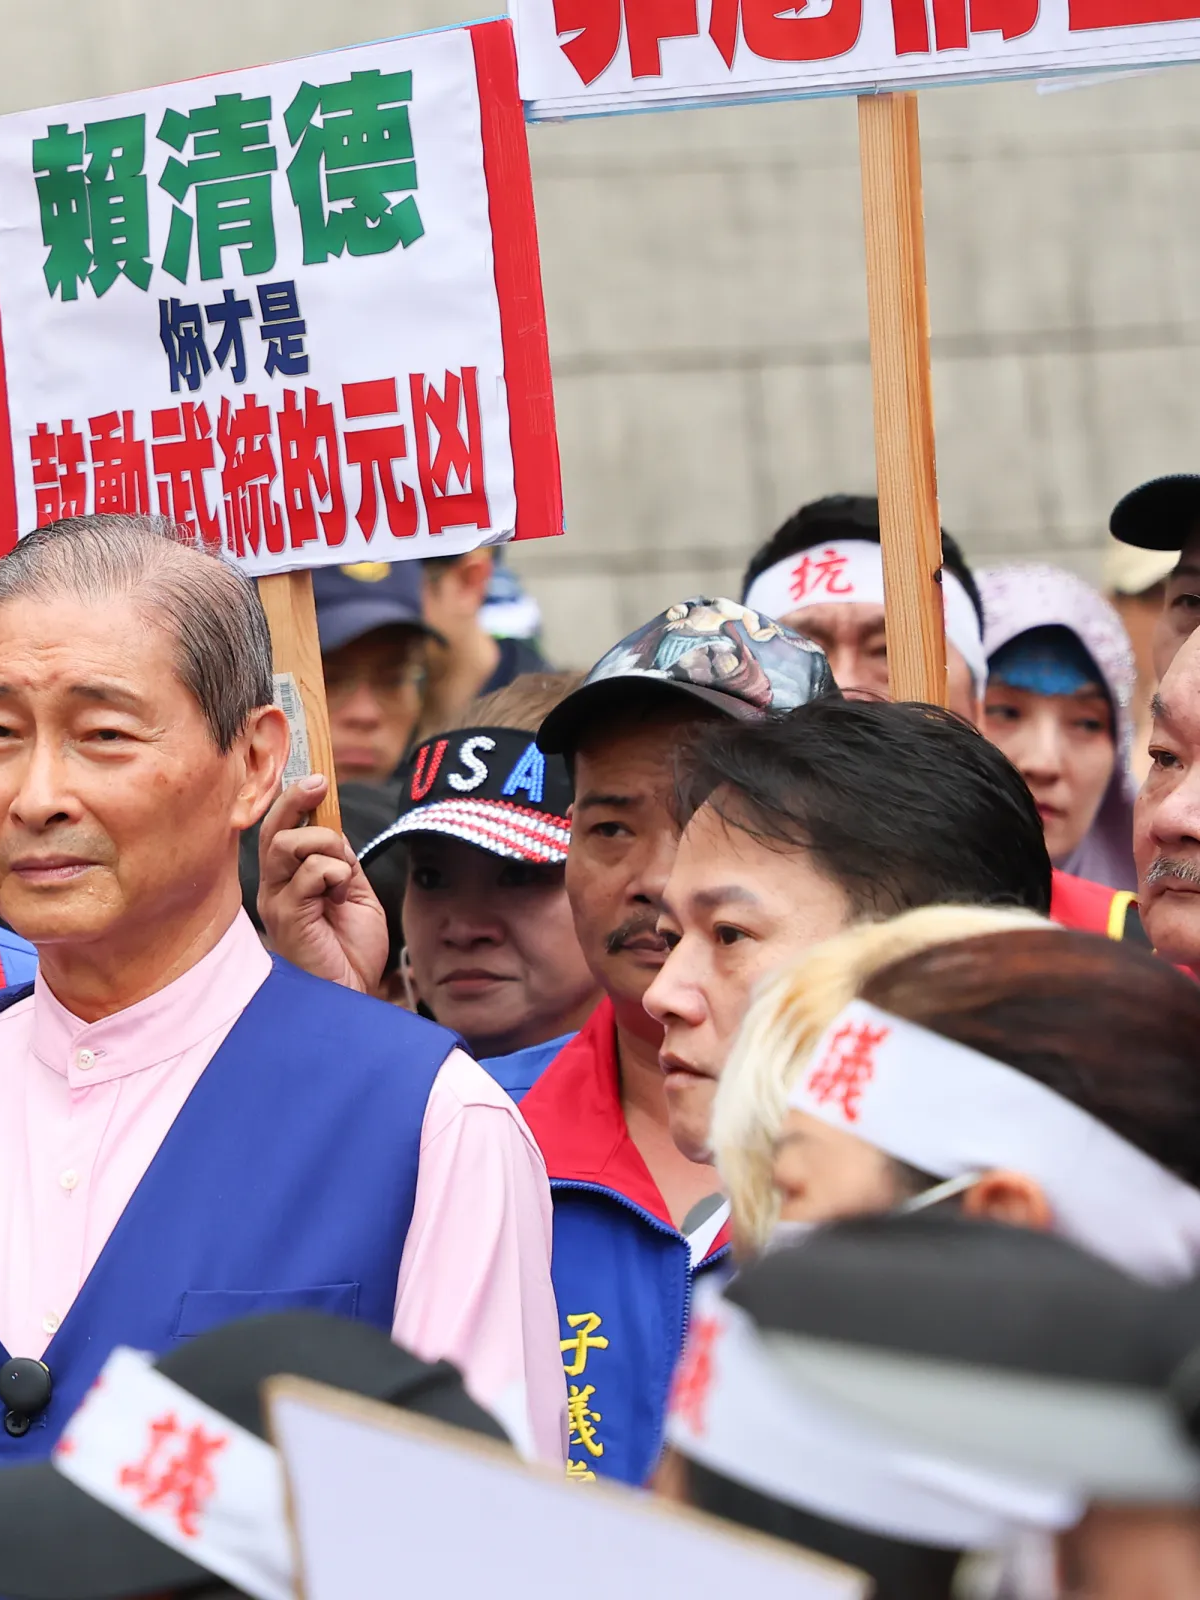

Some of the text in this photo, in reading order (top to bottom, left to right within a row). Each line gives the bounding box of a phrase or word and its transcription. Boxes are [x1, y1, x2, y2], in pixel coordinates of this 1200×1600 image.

[32, 69, 425, 301] 賴清德
[159, 280, 309, 392] 你才是
[29, 366, 493, 559] 鼓動武統的元凶
[789, 549, 853, 602] 抗
[410, 736, 546, 803] USA
